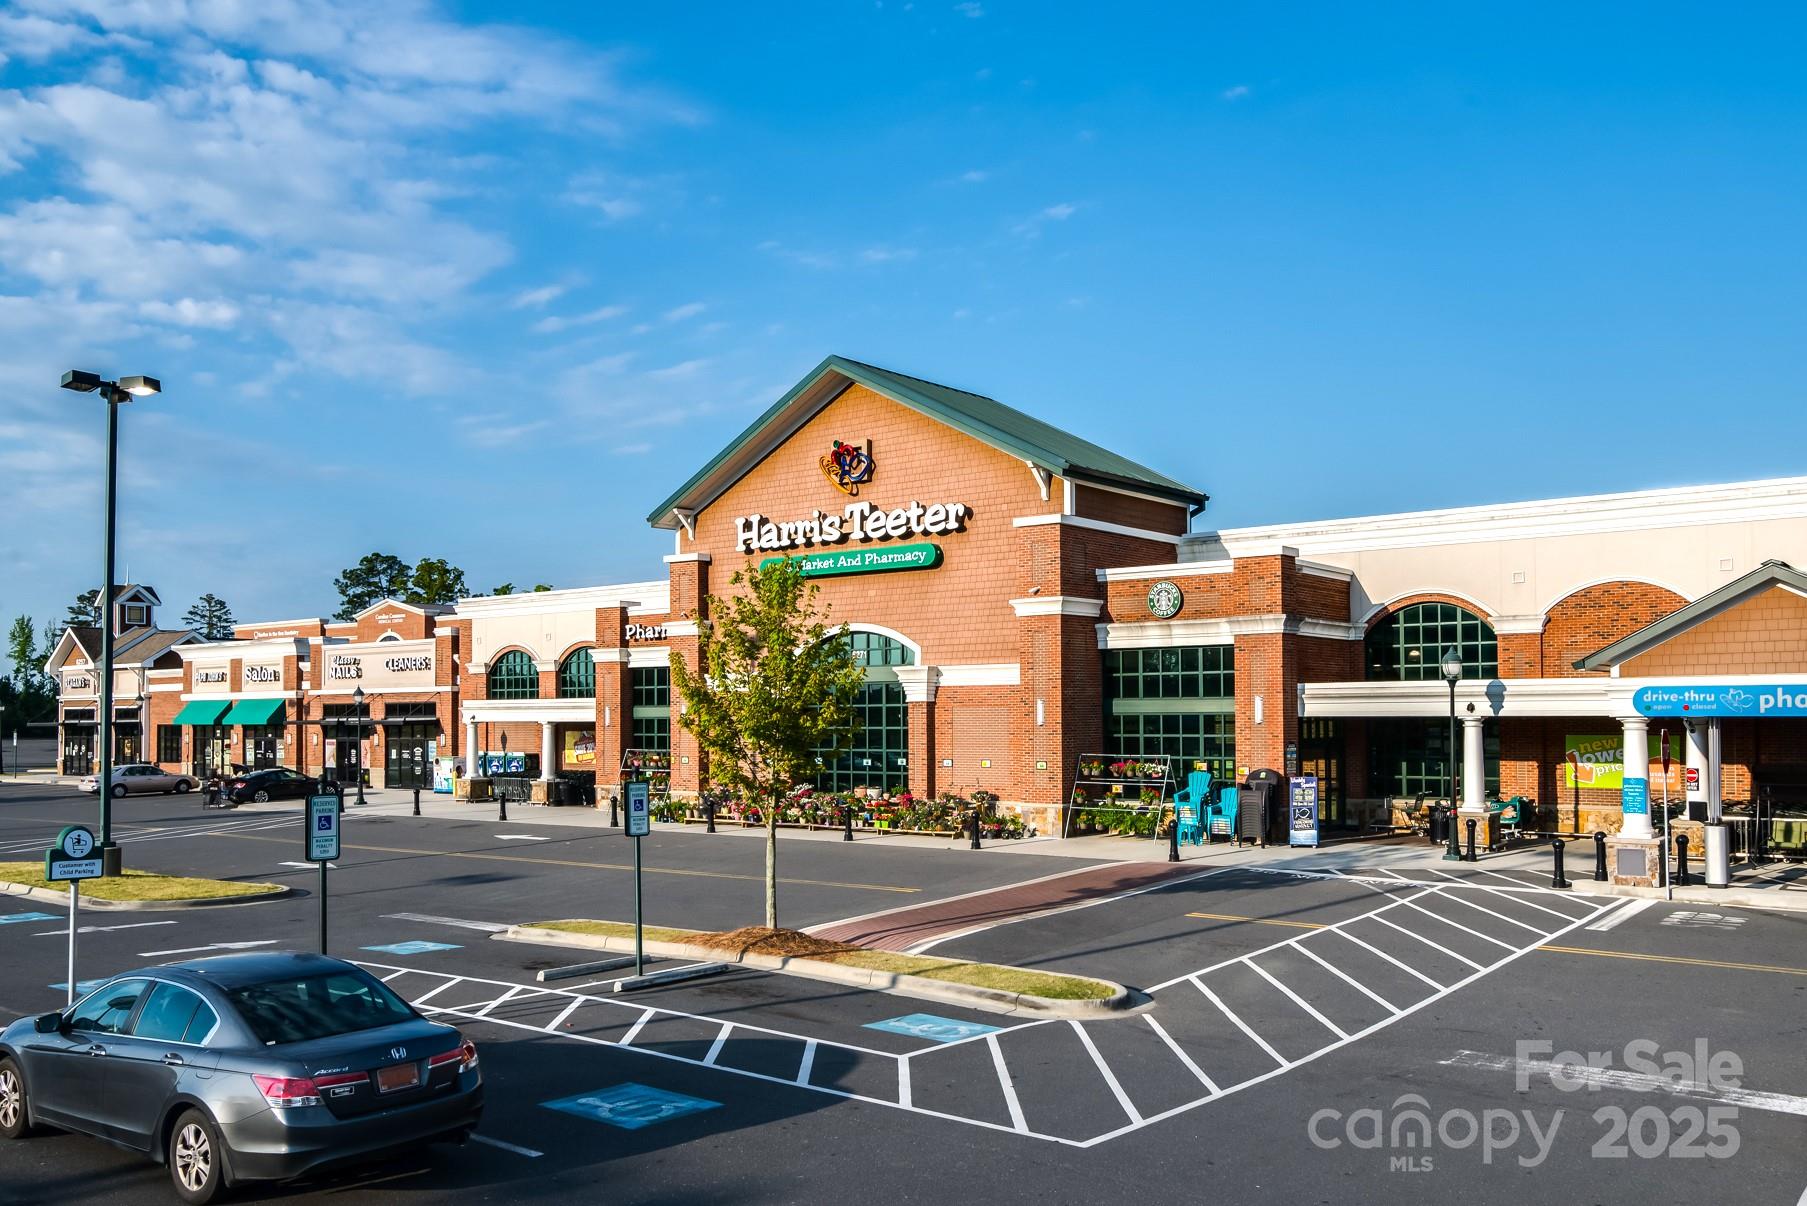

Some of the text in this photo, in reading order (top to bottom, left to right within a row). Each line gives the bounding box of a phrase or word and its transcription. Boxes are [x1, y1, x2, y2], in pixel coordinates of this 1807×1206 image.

[734, 500, 965, 552] Harris Teeter
[838, 553, 862, 568] And
[864, 550, 927, 565] Pharmacy
[1149, 583, 1178, 599] STARBUCKS
[1153, 606, 1175, 616] COFFEE
[384, 656, 429, 671] CLEANERS
[245, 666, 275, 681] Salon
[329, 666, 358, 680] NAILS
[1643, 690, 1715, 702] drive-thru
[1580, 738, 1618, 753] new
